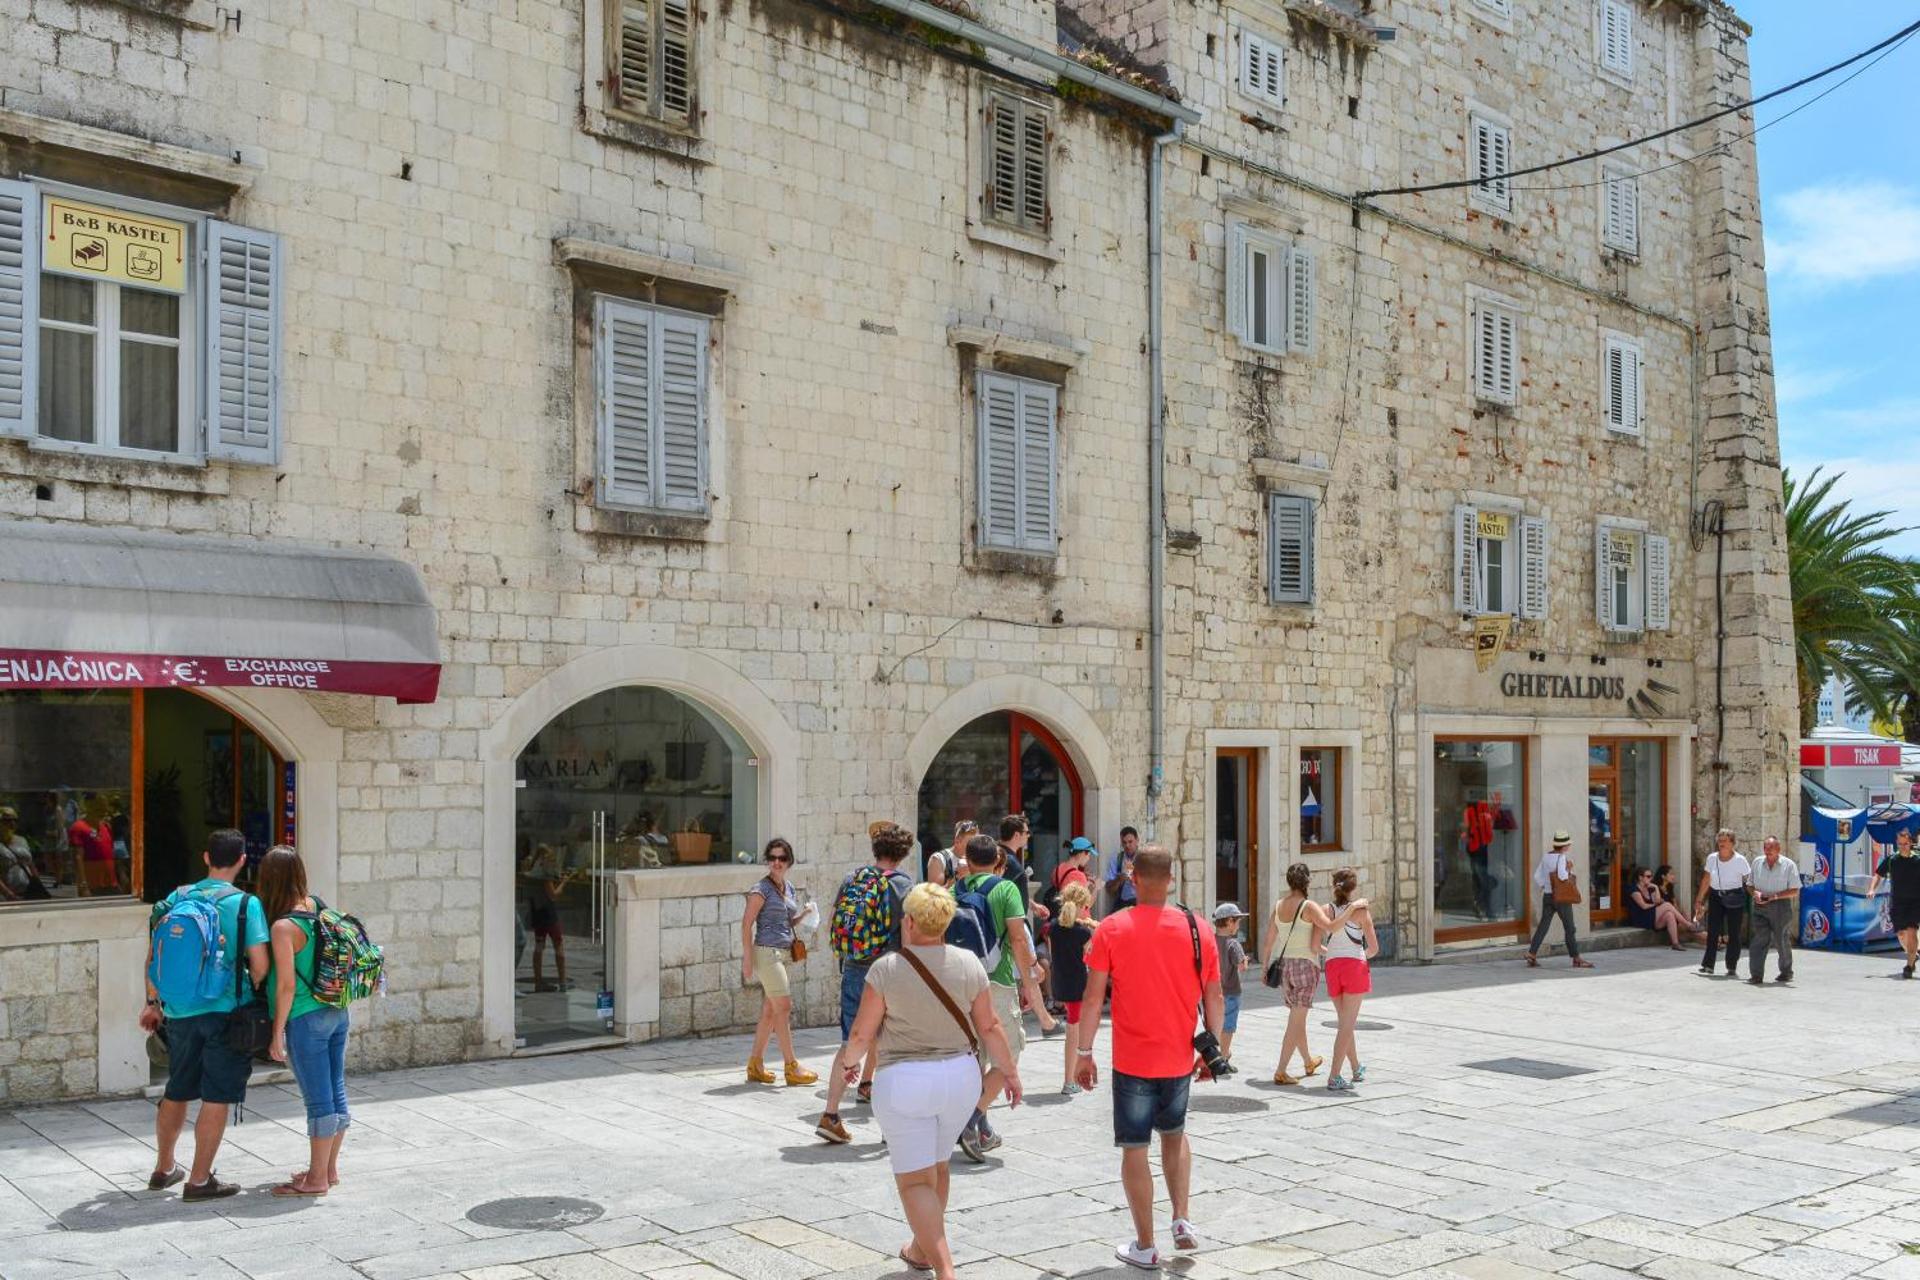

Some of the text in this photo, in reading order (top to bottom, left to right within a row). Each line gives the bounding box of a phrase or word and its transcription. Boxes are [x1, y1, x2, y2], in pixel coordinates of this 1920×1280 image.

[63, 213, 170, 244] B&B KASTEL
[0, 656, 144, 682] ENJAČNICA
[224, 658, 331, 673] EXCHANGE
[251, 674, 318, 688] OFFICE
[1500, 672, 1625, 700] GHETALDUS
[1854, 747, 1880, 765] TISAK
[523, 758, 600, 777] KARLA
